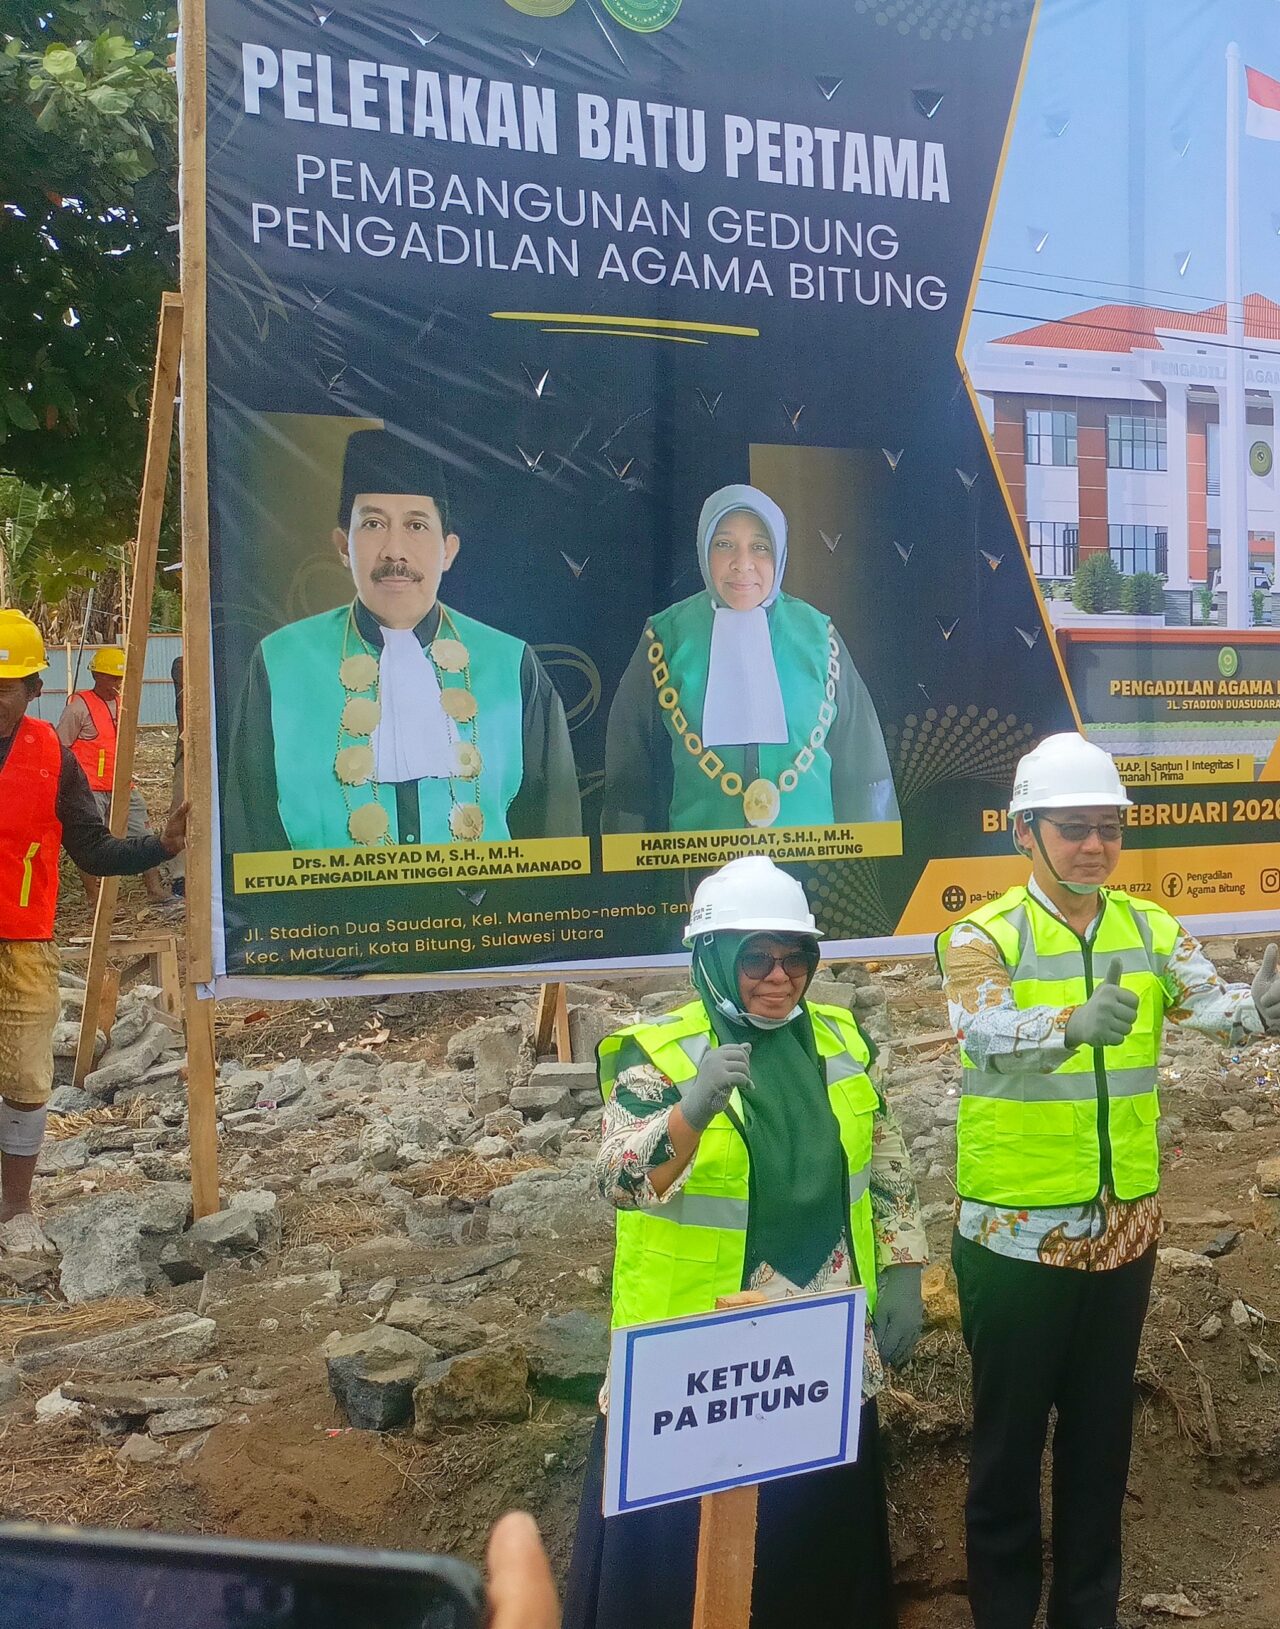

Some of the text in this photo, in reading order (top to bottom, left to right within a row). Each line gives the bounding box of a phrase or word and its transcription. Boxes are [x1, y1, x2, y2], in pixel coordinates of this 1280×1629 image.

[242, 43, 951, 204] PELETAKAN BATU PERTAMA
[296, 154, 900, 260] PEMBANGUNAN GEDUNG
[251, 203, 948, 312] PENGADILAN AGAMA BITUNG
[1110, 680, 1214, 696] PENGADILAN
[1217, 680, 1274, 696] AGAMA
[1166, 701, 1180, 710] JL.
[1182, 700, 1223, 710] STADION
[1119, 772, 1184, 782] manah Prima
[1151, 762, 1182, 772] Santun
[1192, 760, 1234, 774] Integritas
[1126, 801, 1227, 827] EBRUARI
[641, 837, 707, 851] HARISAN
[711, 833, 780, 848] UPUOLAT,
[824, 829, 854, 842] M.H.
[293, 846, 524, 870] Drs. M. ARSYAD M, S.H., M.H.
[636, 853, 680, 867] KETUA
[768, 846, 815, 859] AGAMA
[818, 844, 863, 856] BITUNG
[245, 860, 582, 889] KETUA PENGADILAN TINGGI AGAMA MANADO
[1187, 870, 1233, 883] Pengadilan
[1130, 883, 1152, 892] 8722
[1187, 884, 1246, 898] Agama Bitung
[244, 928, 264, 942] Jl.
[270, 924, 340, 940] Stadion
[346, 921, 380, 935] Dua
[386, 916, 467, 933] Saudara,
[472, 912, 502, 927] Kel.
[507, 903, 656, 925] Manembo-nembo
[245, 927, 604, 965] Kec. Matuari, Kota Bitung, Sulawesi Utara
[687, 1355, 796, 1396] KETUA
[653, 1380, 829, 1436] PA BITUNG
